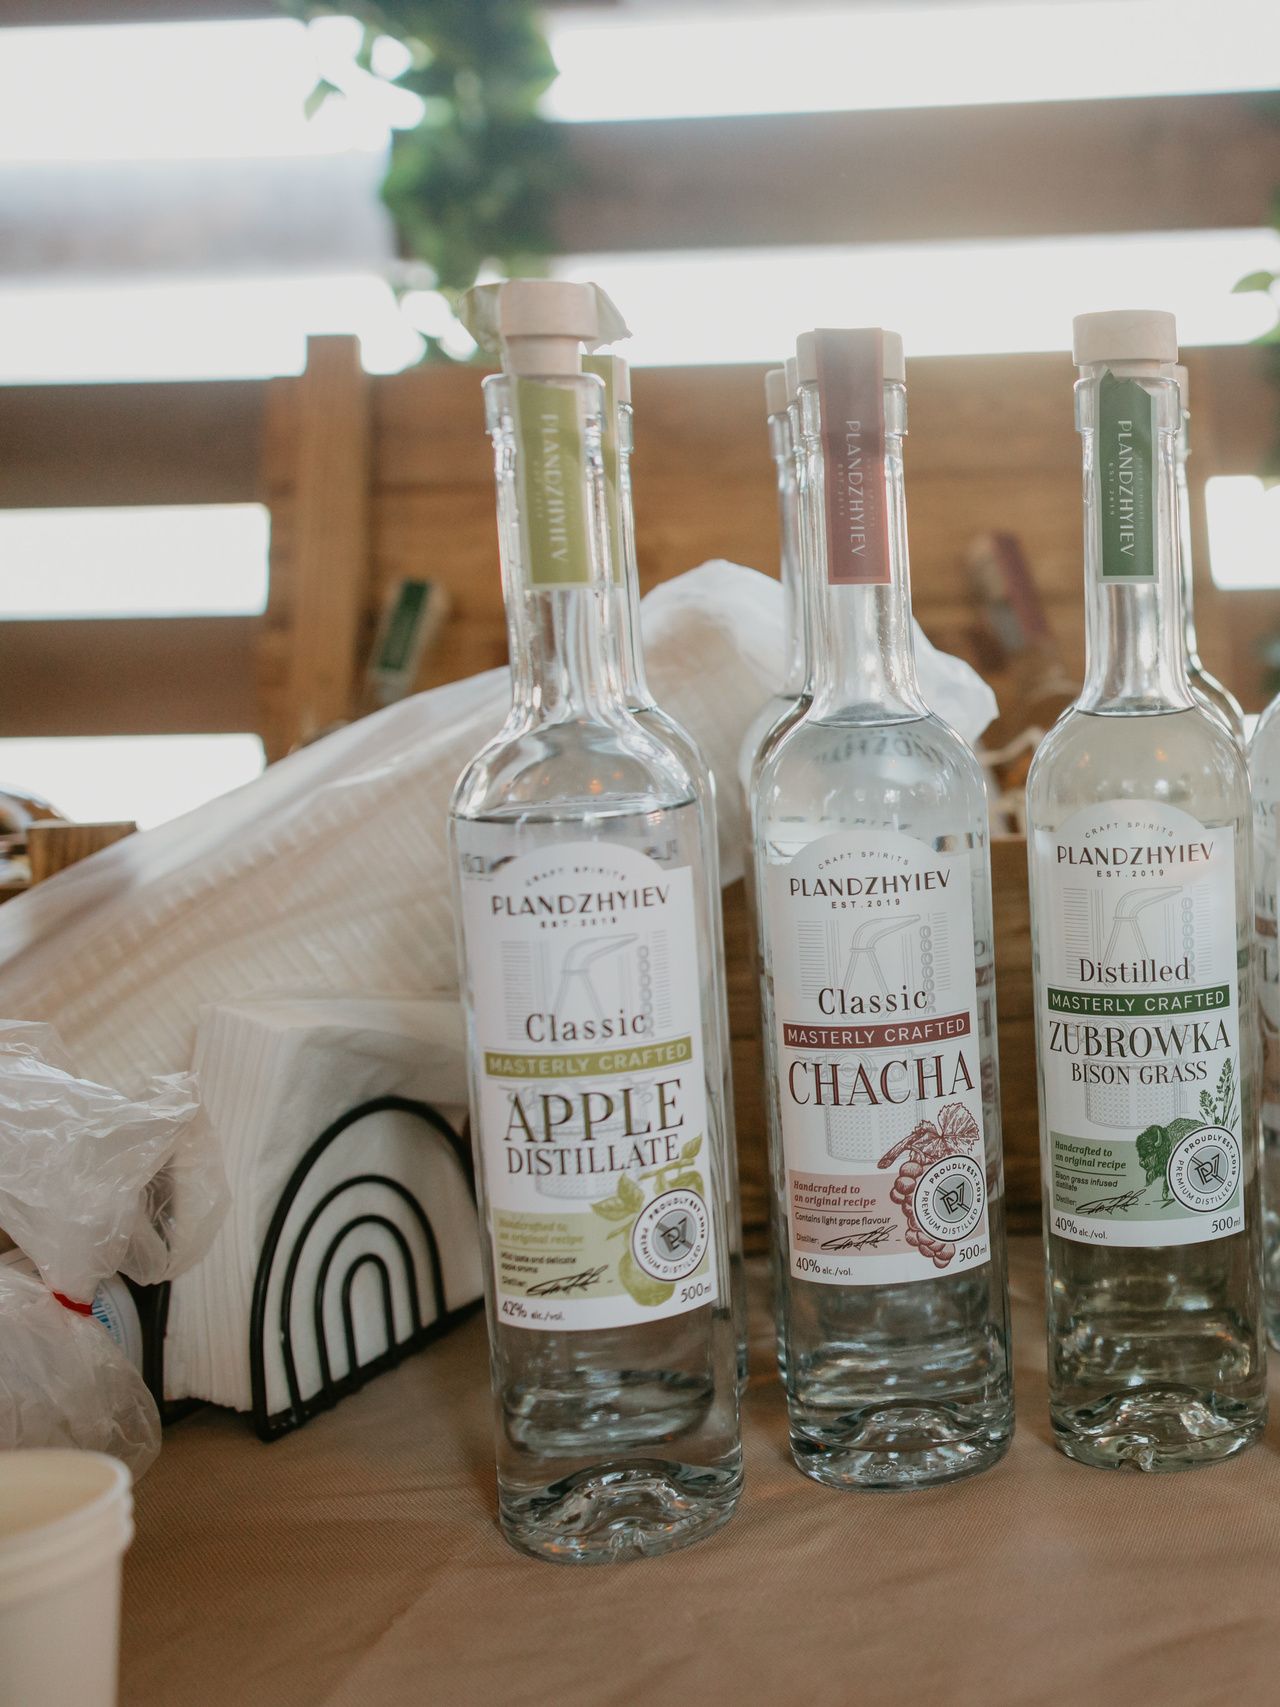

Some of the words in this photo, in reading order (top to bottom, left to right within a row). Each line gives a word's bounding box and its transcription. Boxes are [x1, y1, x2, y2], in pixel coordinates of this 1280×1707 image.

[846, 421, 866, 557] PLANDZHYIEV
[1118, 420, 1135, 557] PLANDZHYIEV
[1085, 823, 1118, 839] CRAFT
[1128, 822, 1173, 837] SPIRITS
[819, 852, 852, 870] CRAFT
[862, 851, 909, 865] SPIRITS
[1057, 842, 1213, 866] PLANDZHYIEV
[790, 869, 950, 897] PLANDZHYIEV
[492, 885, 670, 916] PLANDZHYIEV
[1079, 957, 1190, 983] Distilled
[818, 985, 928, 1015] Classic
[1052, 993, 1135, 1011] MASTERLY
[1144, 991, 1224, 1011] CRAFTED
[526, 1010, 647, 1042] Classic
[788, 1029, 875, 1045] MASTERLY
[884, 1018, 965, 1042] CRAFTED
[1049, 1019, 1231, 1057] ZUBROWKA
[489, 1053, 590, 1075] MASTERLY
[599, 1042, 687, 1070] CRAFTED
[789, 1050, 975, 1106] CHACHA
[1072, 1062, 1130, 1085] BISON
[1140, 1061, 1208, 1084] GRASS
[503, 1079, 684, 1142] APPLE
[507, 1134, 680, 1175] DISTILLATE
[1055, 1141, 1100, 1156] Handcrafted
[1184, 1134, 1221, 1154] PROUDLY
[1055, 1154, 1063, 1162] an
[1065, 1155, 1095, 1168] original
[1098, 1159, 1126, 1171] recipe
[929, 1163, 966, 1184] PROUDLY
[1055, 1171, 1069, 1181] Bison
[1071, 1176, 1088, 1186] grass
[1090, 1178, 1118, 1188] infused
[1176, 1160, 1194, 1201] PREMIUM
[1195, 1181, 1232, 1205] DISTILLED
[794, 1180, 848, 1196] Handcrafted
[850, 1186, 860, 1194] to
[1056, 1181, 1077, 1191] distillate
[794, 1195, 803, 1203] an
[805, 1194, 840, 1208] original
[843, 1197, 876, 1208] recipe
[1056, 1195, 1077, 1206] Distiller:
[795, 1213, 820, 1224] Contains
[822, 1214, 837, 1225] light
[839, 1217, 860, 1227] grape
[862, 1216, 890, 1224] flavour
[921, 1190, 941, 1231] PREMIUM
[942, 1208, 978, 1234] DISTILLED
[1055, 1217, 1077, 1234] 40%
[1079, 1228, 1107, 1239] alc./vol.
[1211, 1217, 1240, 1233] 500ml
[797, 1233, 819, 1244] Distiller:
[661, 1244, 701, 1274] DISTILLED
[959, 1244, 987, 1262] 500ml
[796, 1257, 821, 1273] 40%
[822, 1263, 853, 1276] alc./vol.
[681, 1283, 712, 1303] 500ml
[502, 1301, 527, 1319] 42%
